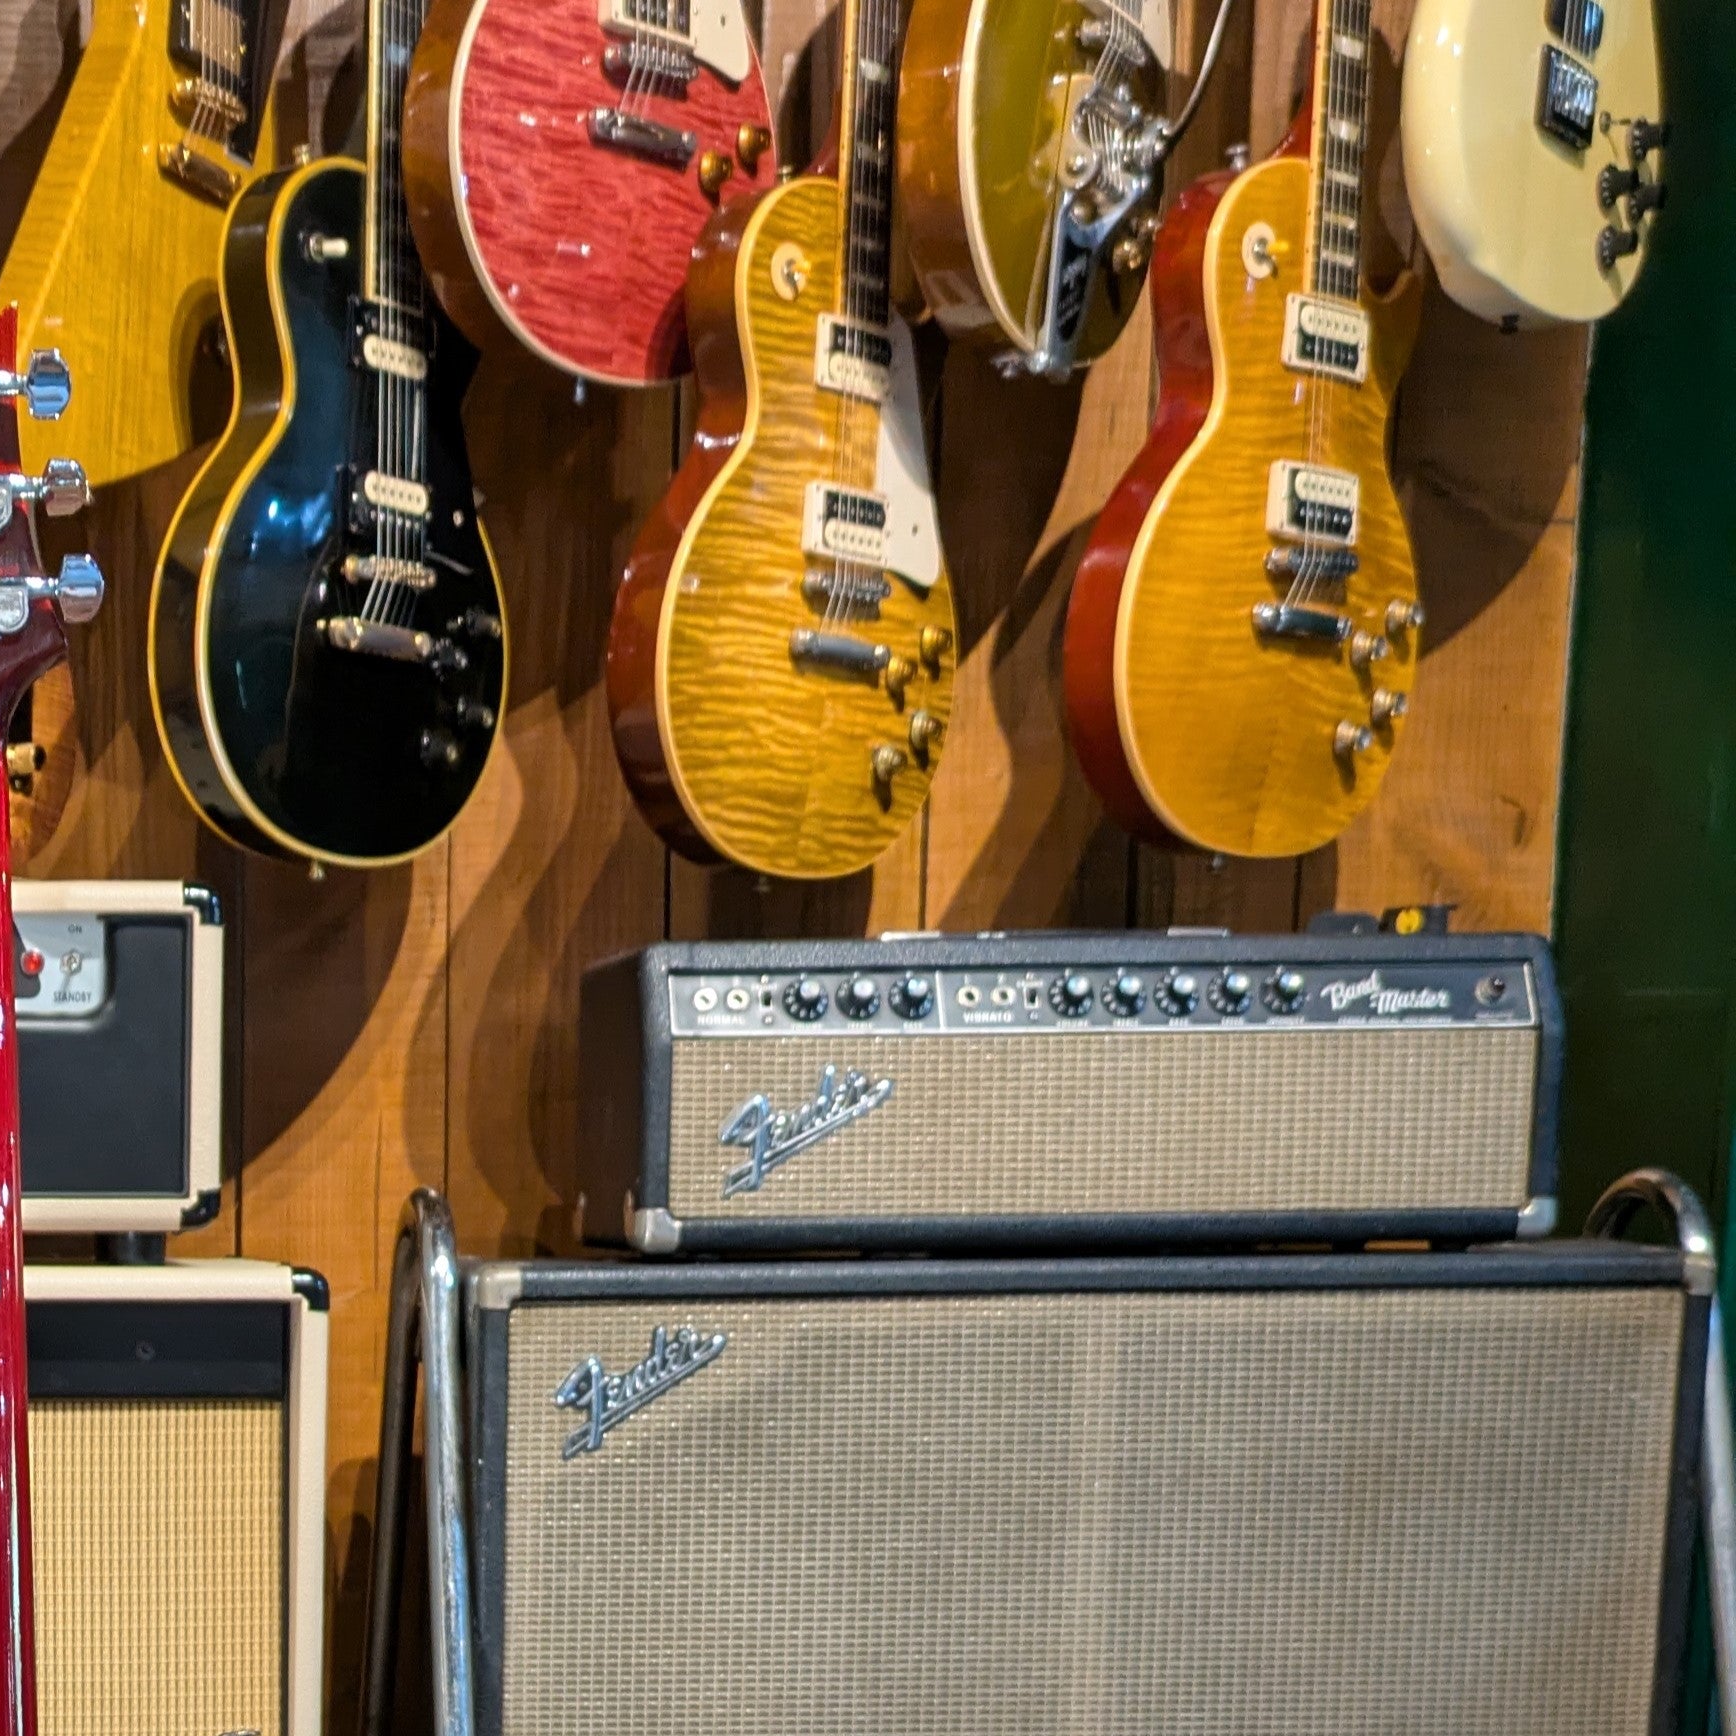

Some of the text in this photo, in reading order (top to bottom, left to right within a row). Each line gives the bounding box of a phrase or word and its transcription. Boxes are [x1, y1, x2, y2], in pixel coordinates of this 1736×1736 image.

[67, 924, 83, 934] ON
[1319, 968, 1383, 1012] Band
[53, 991, 92, 1003] STANDBY
[697, 1014, 746, 1026] NORMAL
[963, 1011, 1013, 1023] VIBRATO
[720, 1063, 894, 1200] Fender
[553, 1323, 727, 1460] Fender
